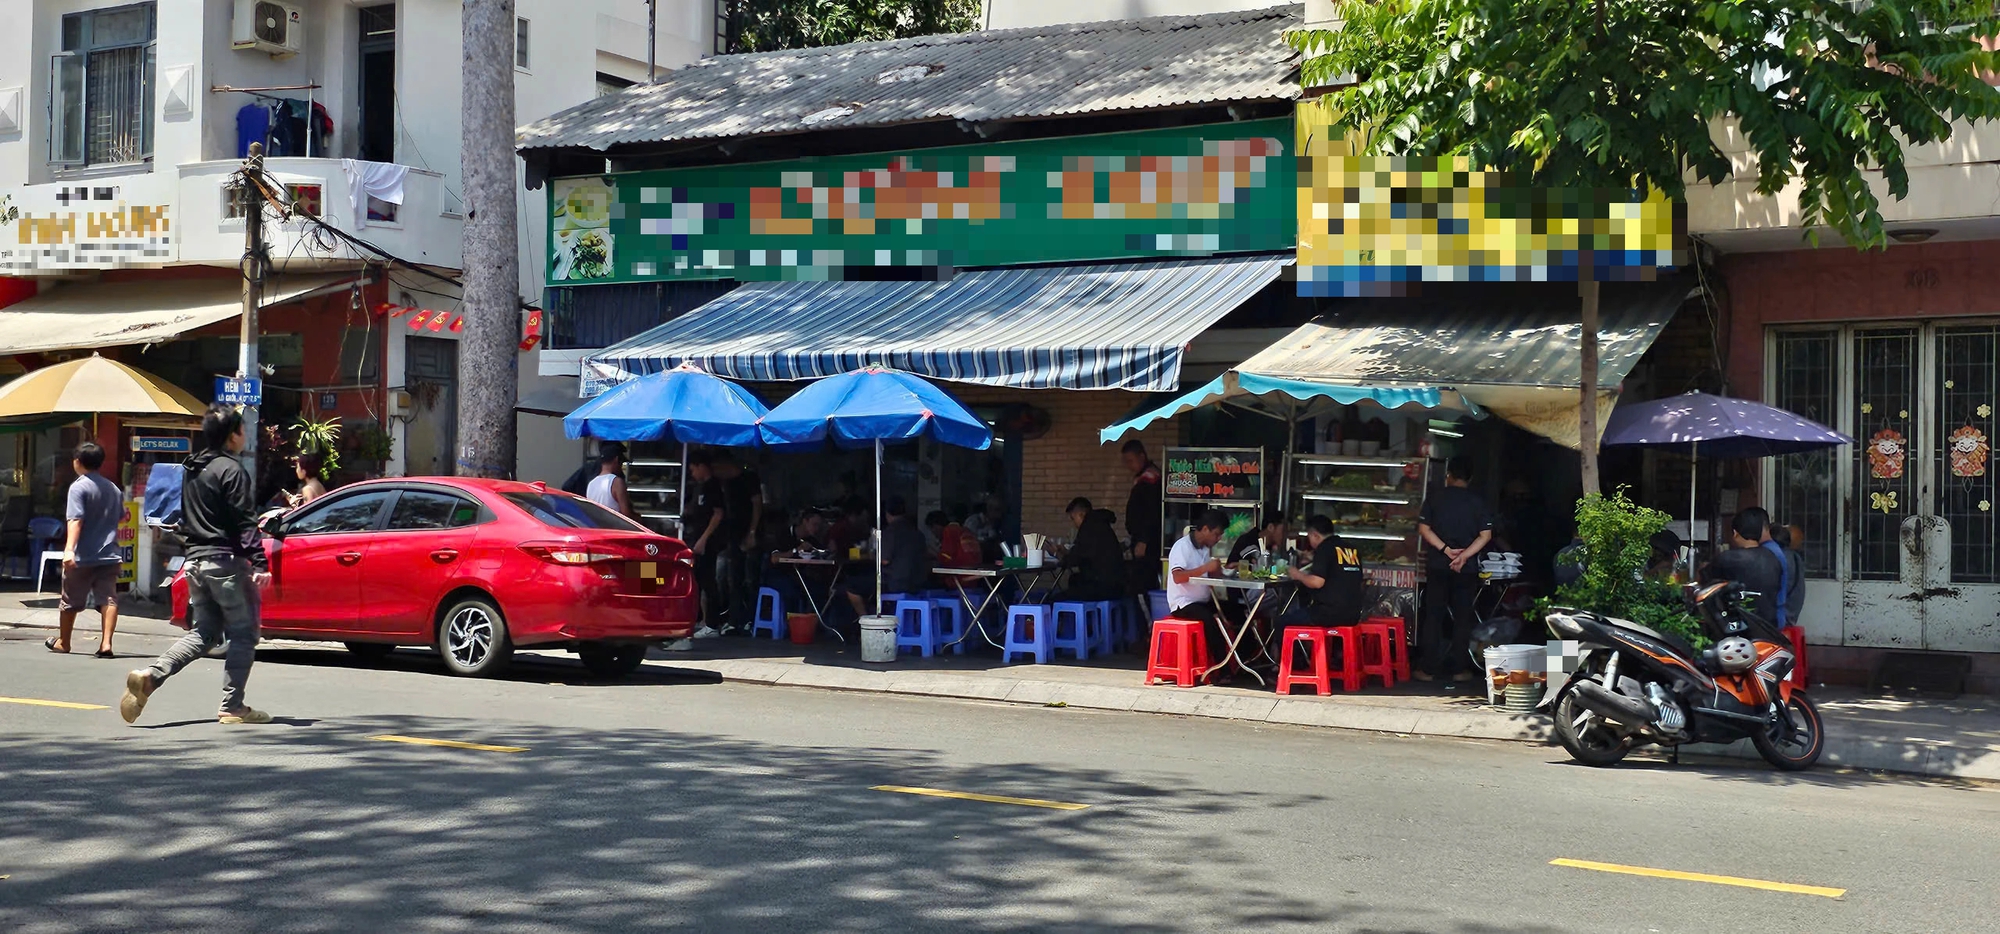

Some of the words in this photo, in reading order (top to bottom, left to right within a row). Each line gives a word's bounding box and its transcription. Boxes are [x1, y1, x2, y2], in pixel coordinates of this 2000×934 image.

[244, 383, 251, 393] 12
[140, 440, 157, 448] LET'S
[158, 440, 179, 448] RELAX
